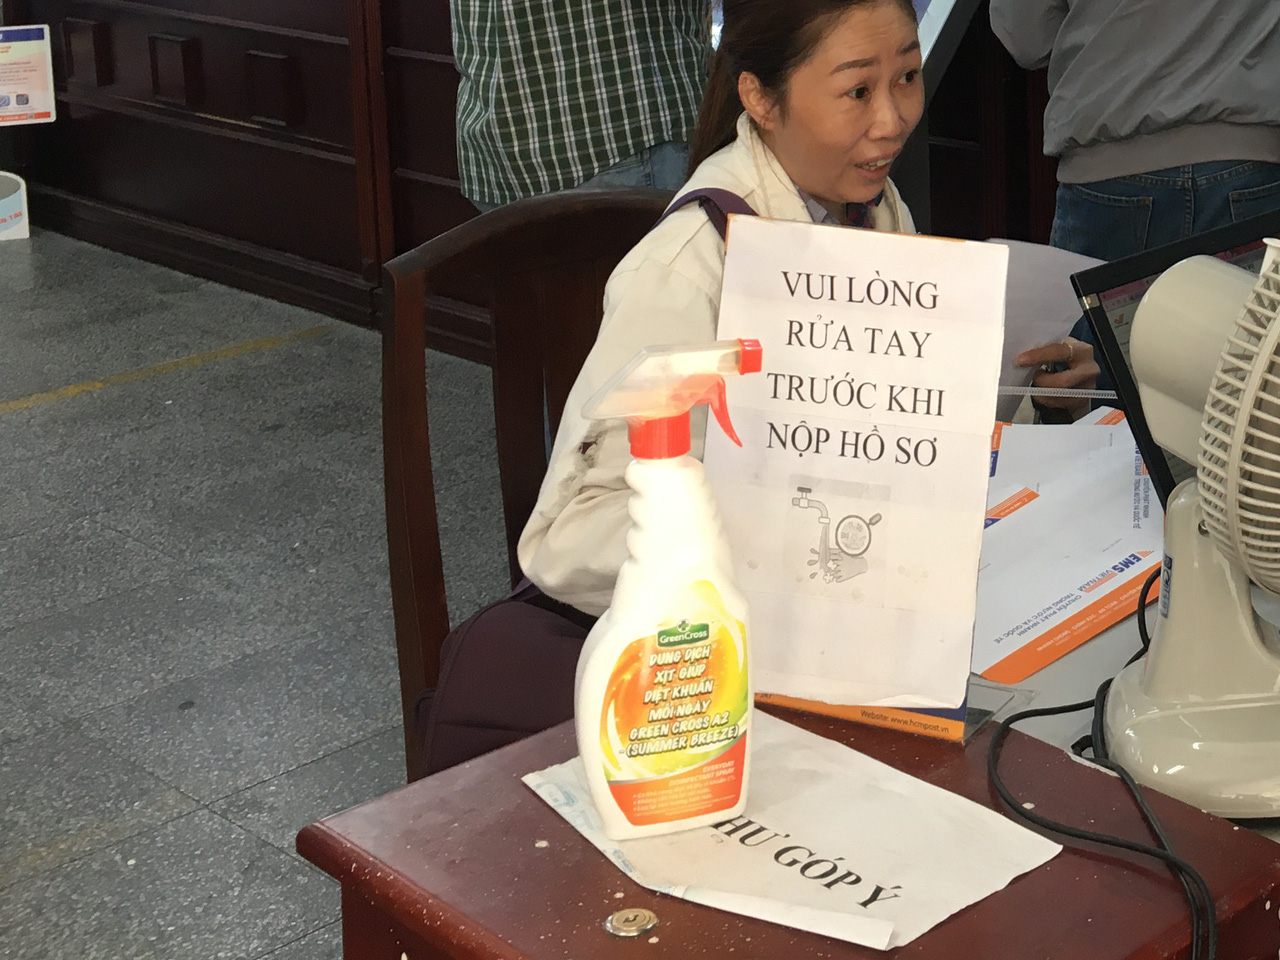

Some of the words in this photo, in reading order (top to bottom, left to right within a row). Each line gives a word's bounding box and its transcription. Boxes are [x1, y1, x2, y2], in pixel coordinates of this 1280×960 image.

[781, 271, 837, 301] VUI
[846, 270, 939, 310] LÒNG
[785, 314, 854, 352] RỬA
[864, 327, 932, 358] TAY
[767, 372, 877, 410] TRƯỚC
[886, 384, 946, 417] KHI
[766, 420, 830, 458] NỘP
[838, 425, 886, 462] HỒ
[895, 437, 938, 467] SƠ
[1111, 553, 1142, 574] EMS
[1077, 569, 1113, 592] VIETNAM
[659, 630, 707, 644] GreenCross
[649, 650, 682, 667] DUNG
[684, 645, 711, 664] DỊCH
[654, 668, 676, 685] XỊT
[679, 663, 706, 681] GIÚP
[643, 688, 671, 706] DIỆT
[671, 677, 713, 700] KHUẨN
[675, 700, 711, 718] NGÀY
[861, 709, 889, 722] Website:
[890, 718, 949, 734] www.hcmpost.vn
[629, 724, 669, 740] GREEN
[671, 716, 710, 735] CROSS
[710, 711, 729, 727] A2
[626, 736, 687, 758] (SUMMER
[689, 724, 739, 747] BREEZE)
[702, 760, 735, 773] EVERYDAY
[715, 767, 735, 778] SPRAY
[710, 814, 791, 847] HƯ
[774, 845, 862, 890] GÓP
[855, 885, 903, 909] Ý
